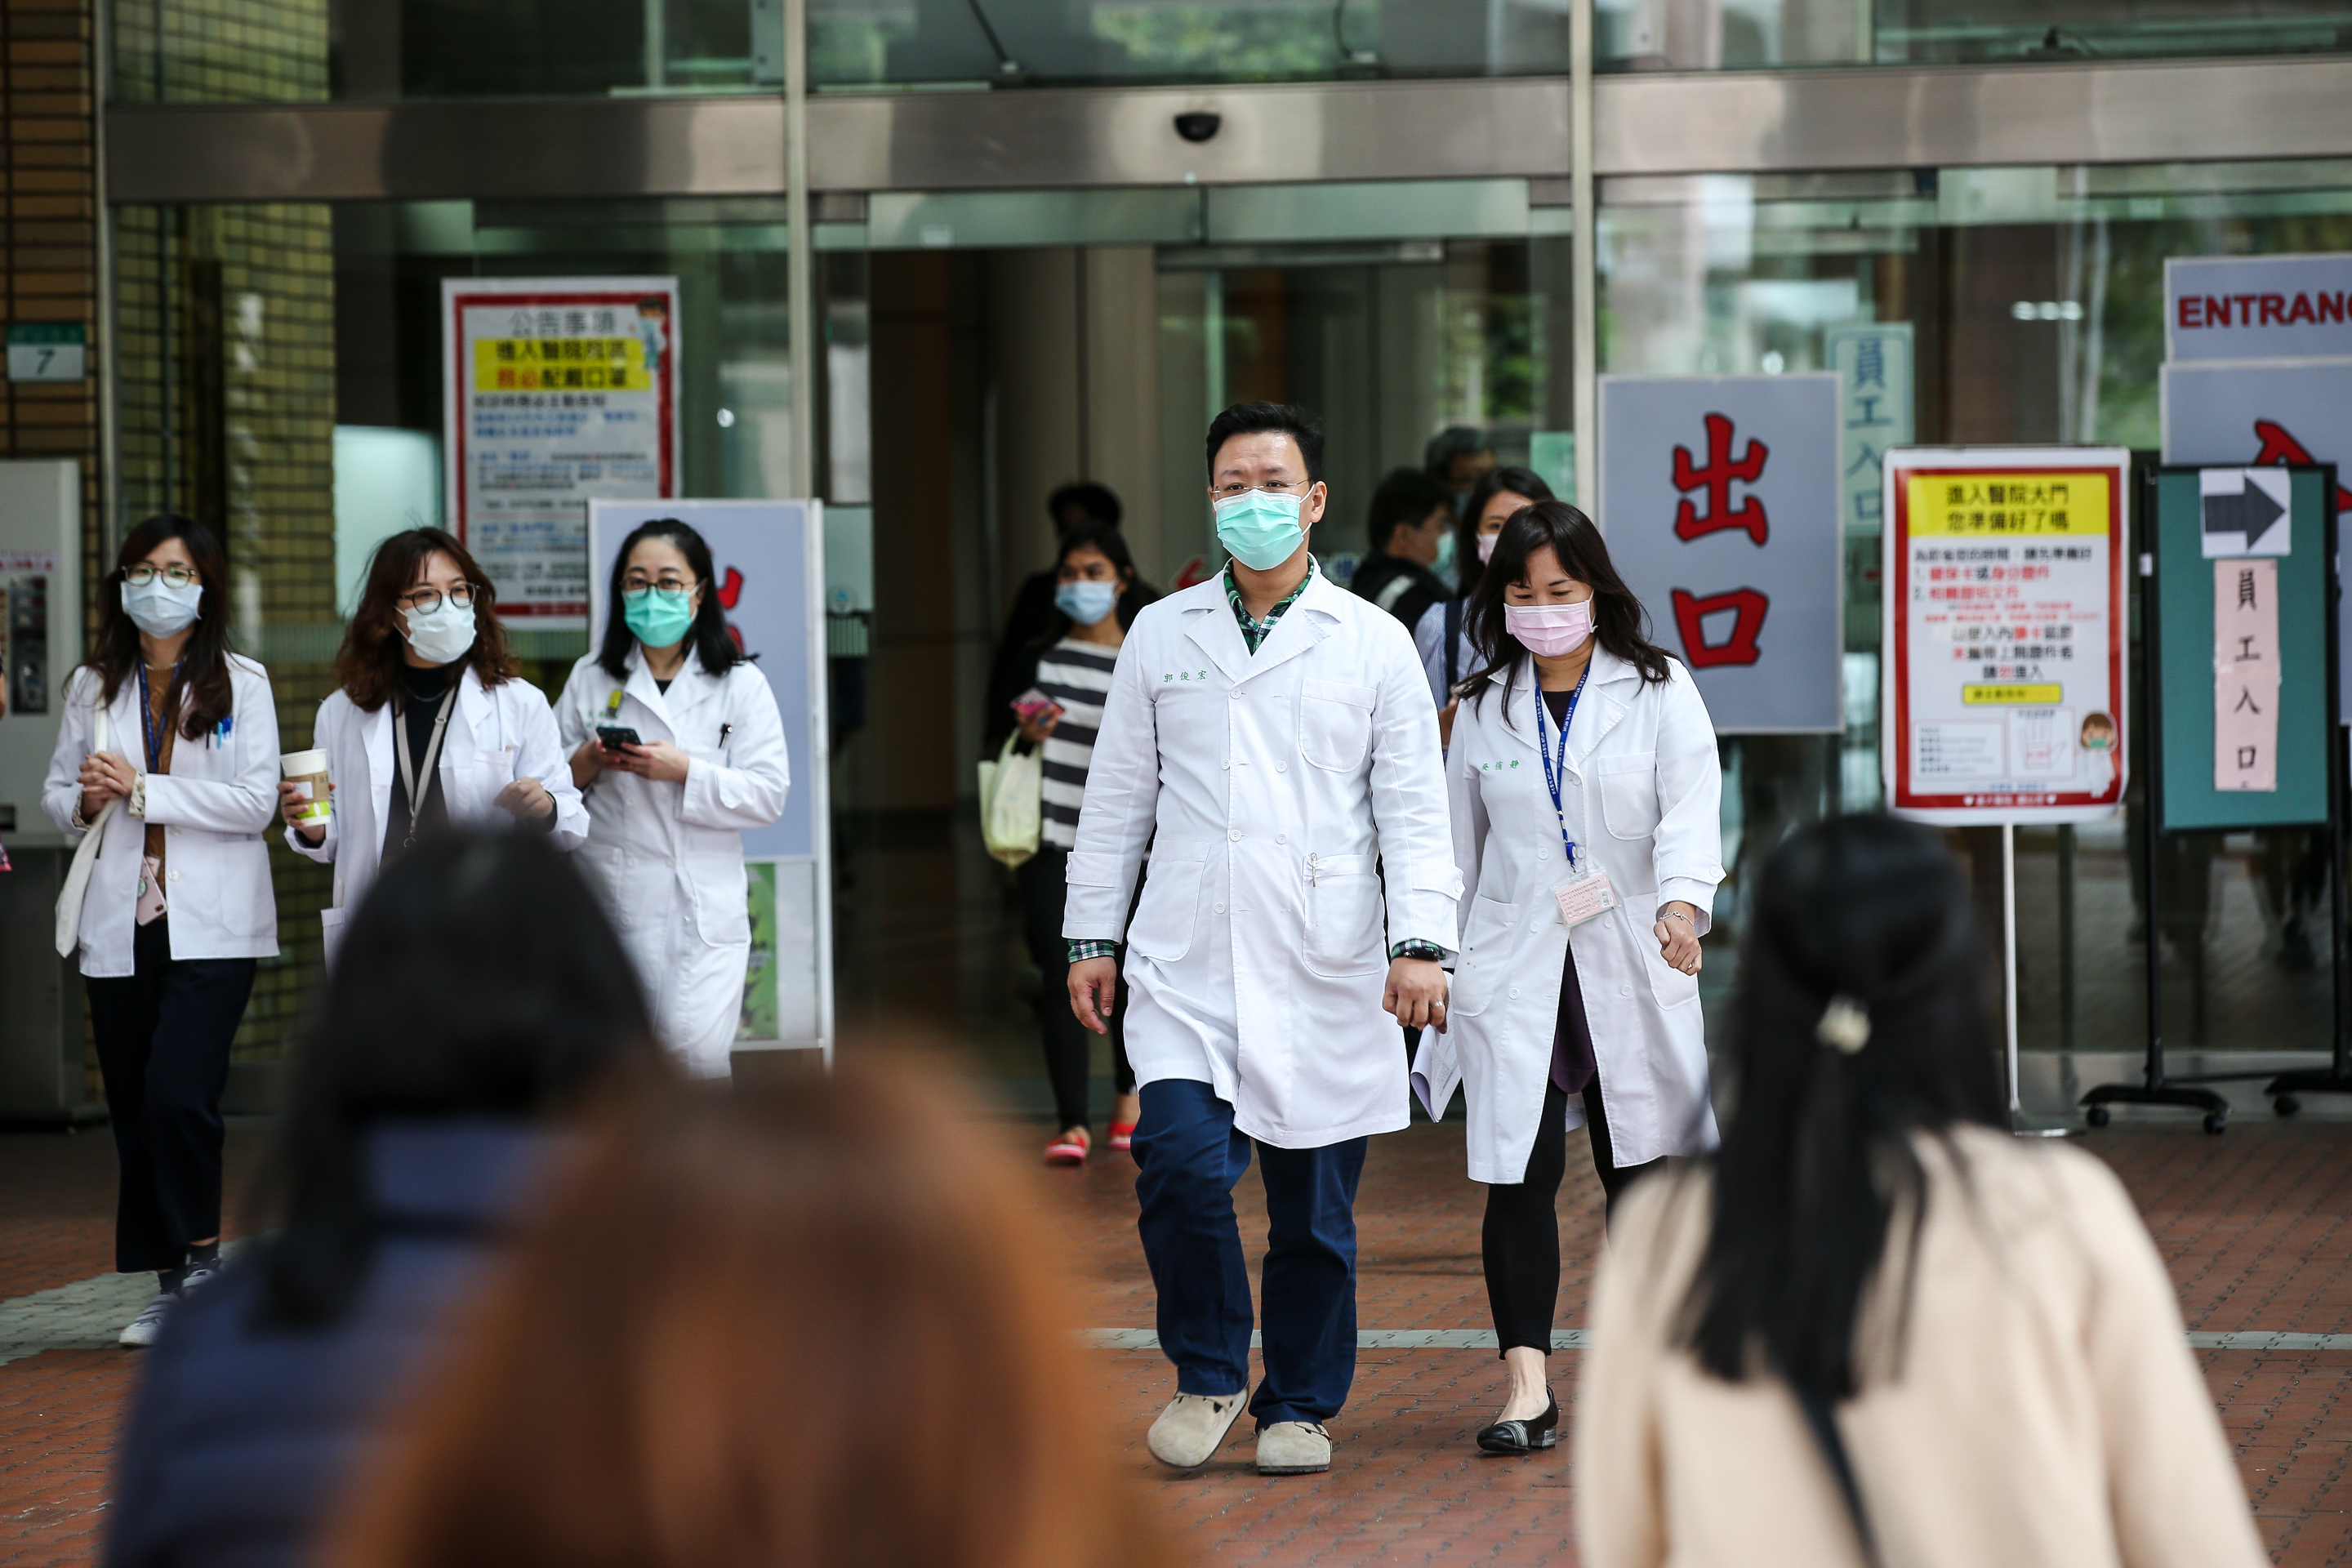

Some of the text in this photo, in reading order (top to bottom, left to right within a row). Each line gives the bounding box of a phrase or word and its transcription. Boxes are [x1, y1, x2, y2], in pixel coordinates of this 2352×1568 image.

[2178, 290, 2352, 328] ENTRAN
[509, 310, 616, 337] 公告事項
[36, 349, 56, 375] 7
[1846, 337, 1893, 520] 員工入口
[1947, 483, 2069, 506] 進入醫院大門
[1947, 509, 2069, 532] 您準備好了嗎
[1670, 411, 1770, 669] 出口
[1983, 665, 2044, 681] 請勿進入
[2234, 568, 2261, 771] 員工入口
